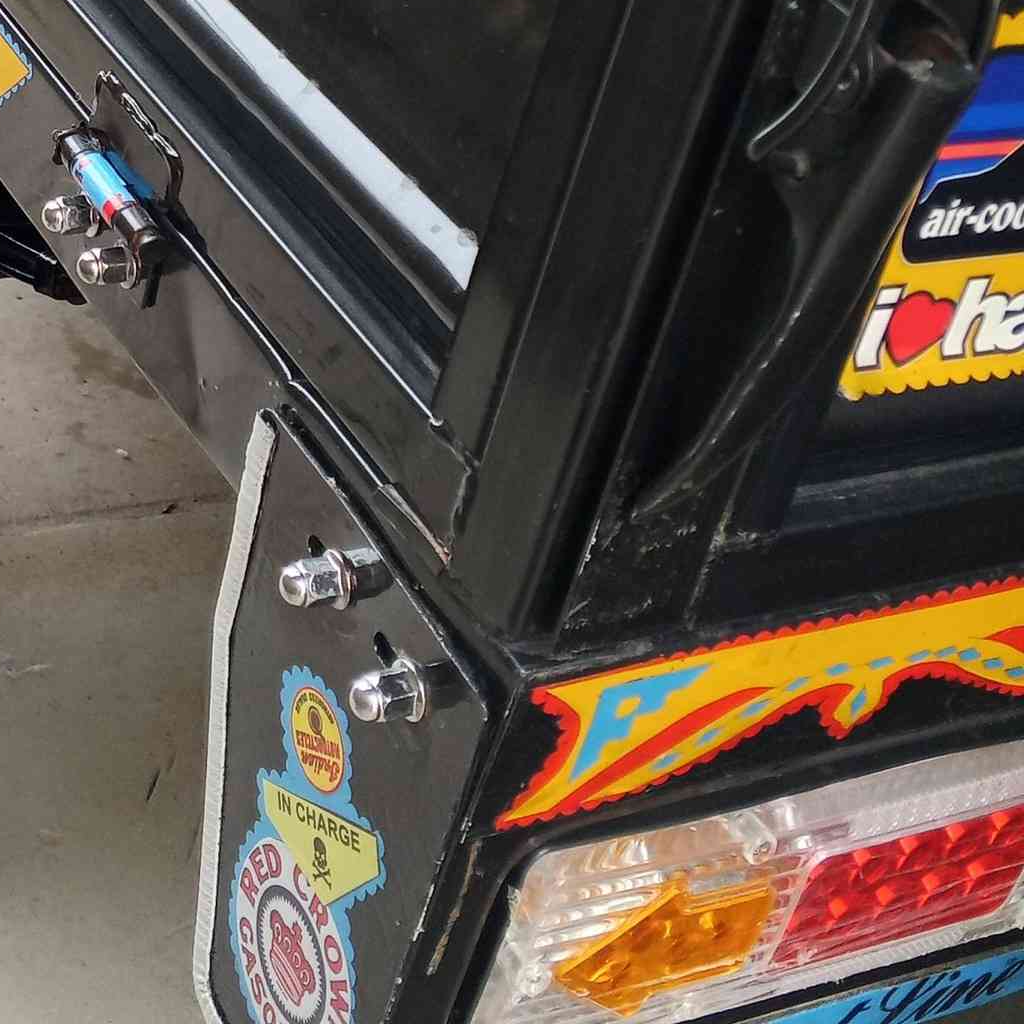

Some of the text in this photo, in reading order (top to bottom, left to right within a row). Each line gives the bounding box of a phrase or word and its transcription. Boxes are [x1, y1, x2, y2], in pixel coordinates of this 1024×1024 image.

[277, 791, 361, 854] IN CHARGE
[240, 843, 282, 908] RED
